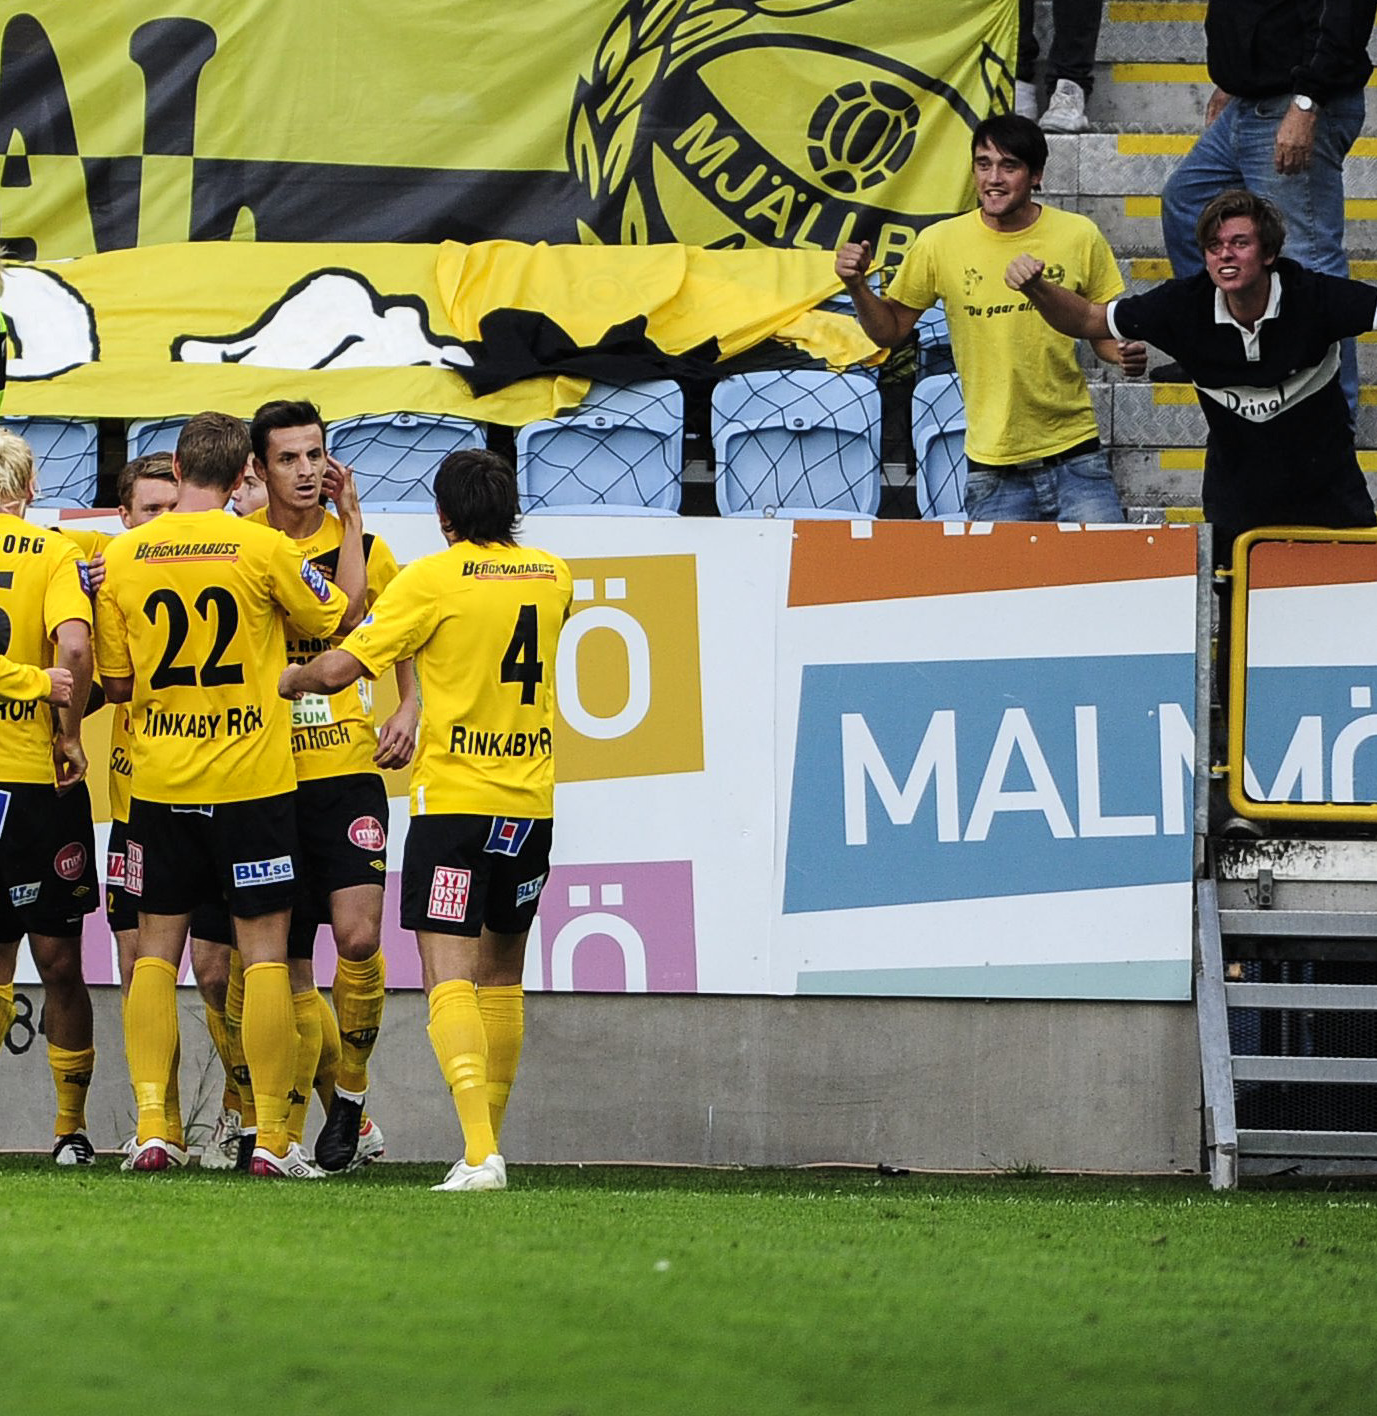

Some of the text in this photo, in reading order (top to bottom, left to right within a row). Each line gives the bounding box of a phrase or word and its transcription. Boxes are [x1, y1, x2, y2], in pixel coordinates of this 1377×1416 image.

[143, 586, 245, 691] 22
[500, 604, 544, 706] 4
[449, 725, 543, 757] RINKABY
[235, 861, 291, 880] BLT.se
[435, 869, 467, 888] SYD
[431, 900, 464, 918] RAN
